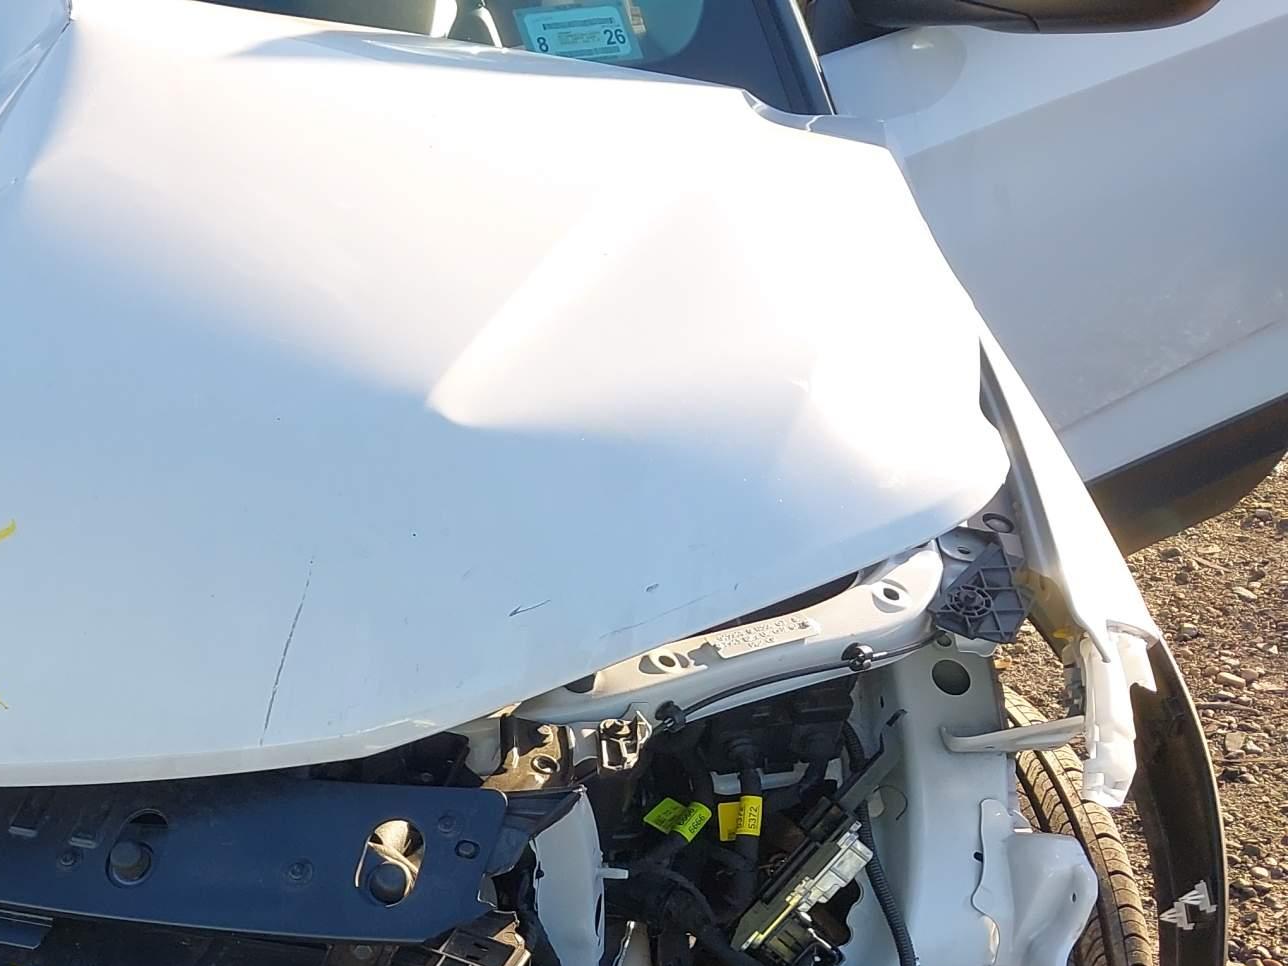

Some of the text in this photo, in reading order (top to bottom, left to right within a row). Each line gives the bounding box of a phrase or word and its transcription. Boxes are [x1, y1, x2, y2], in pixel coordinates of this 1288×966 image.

[536, 36, 549, 53] 8
[603, 28, 626, 45] 26
[747, 805, 759, 830] 5372
